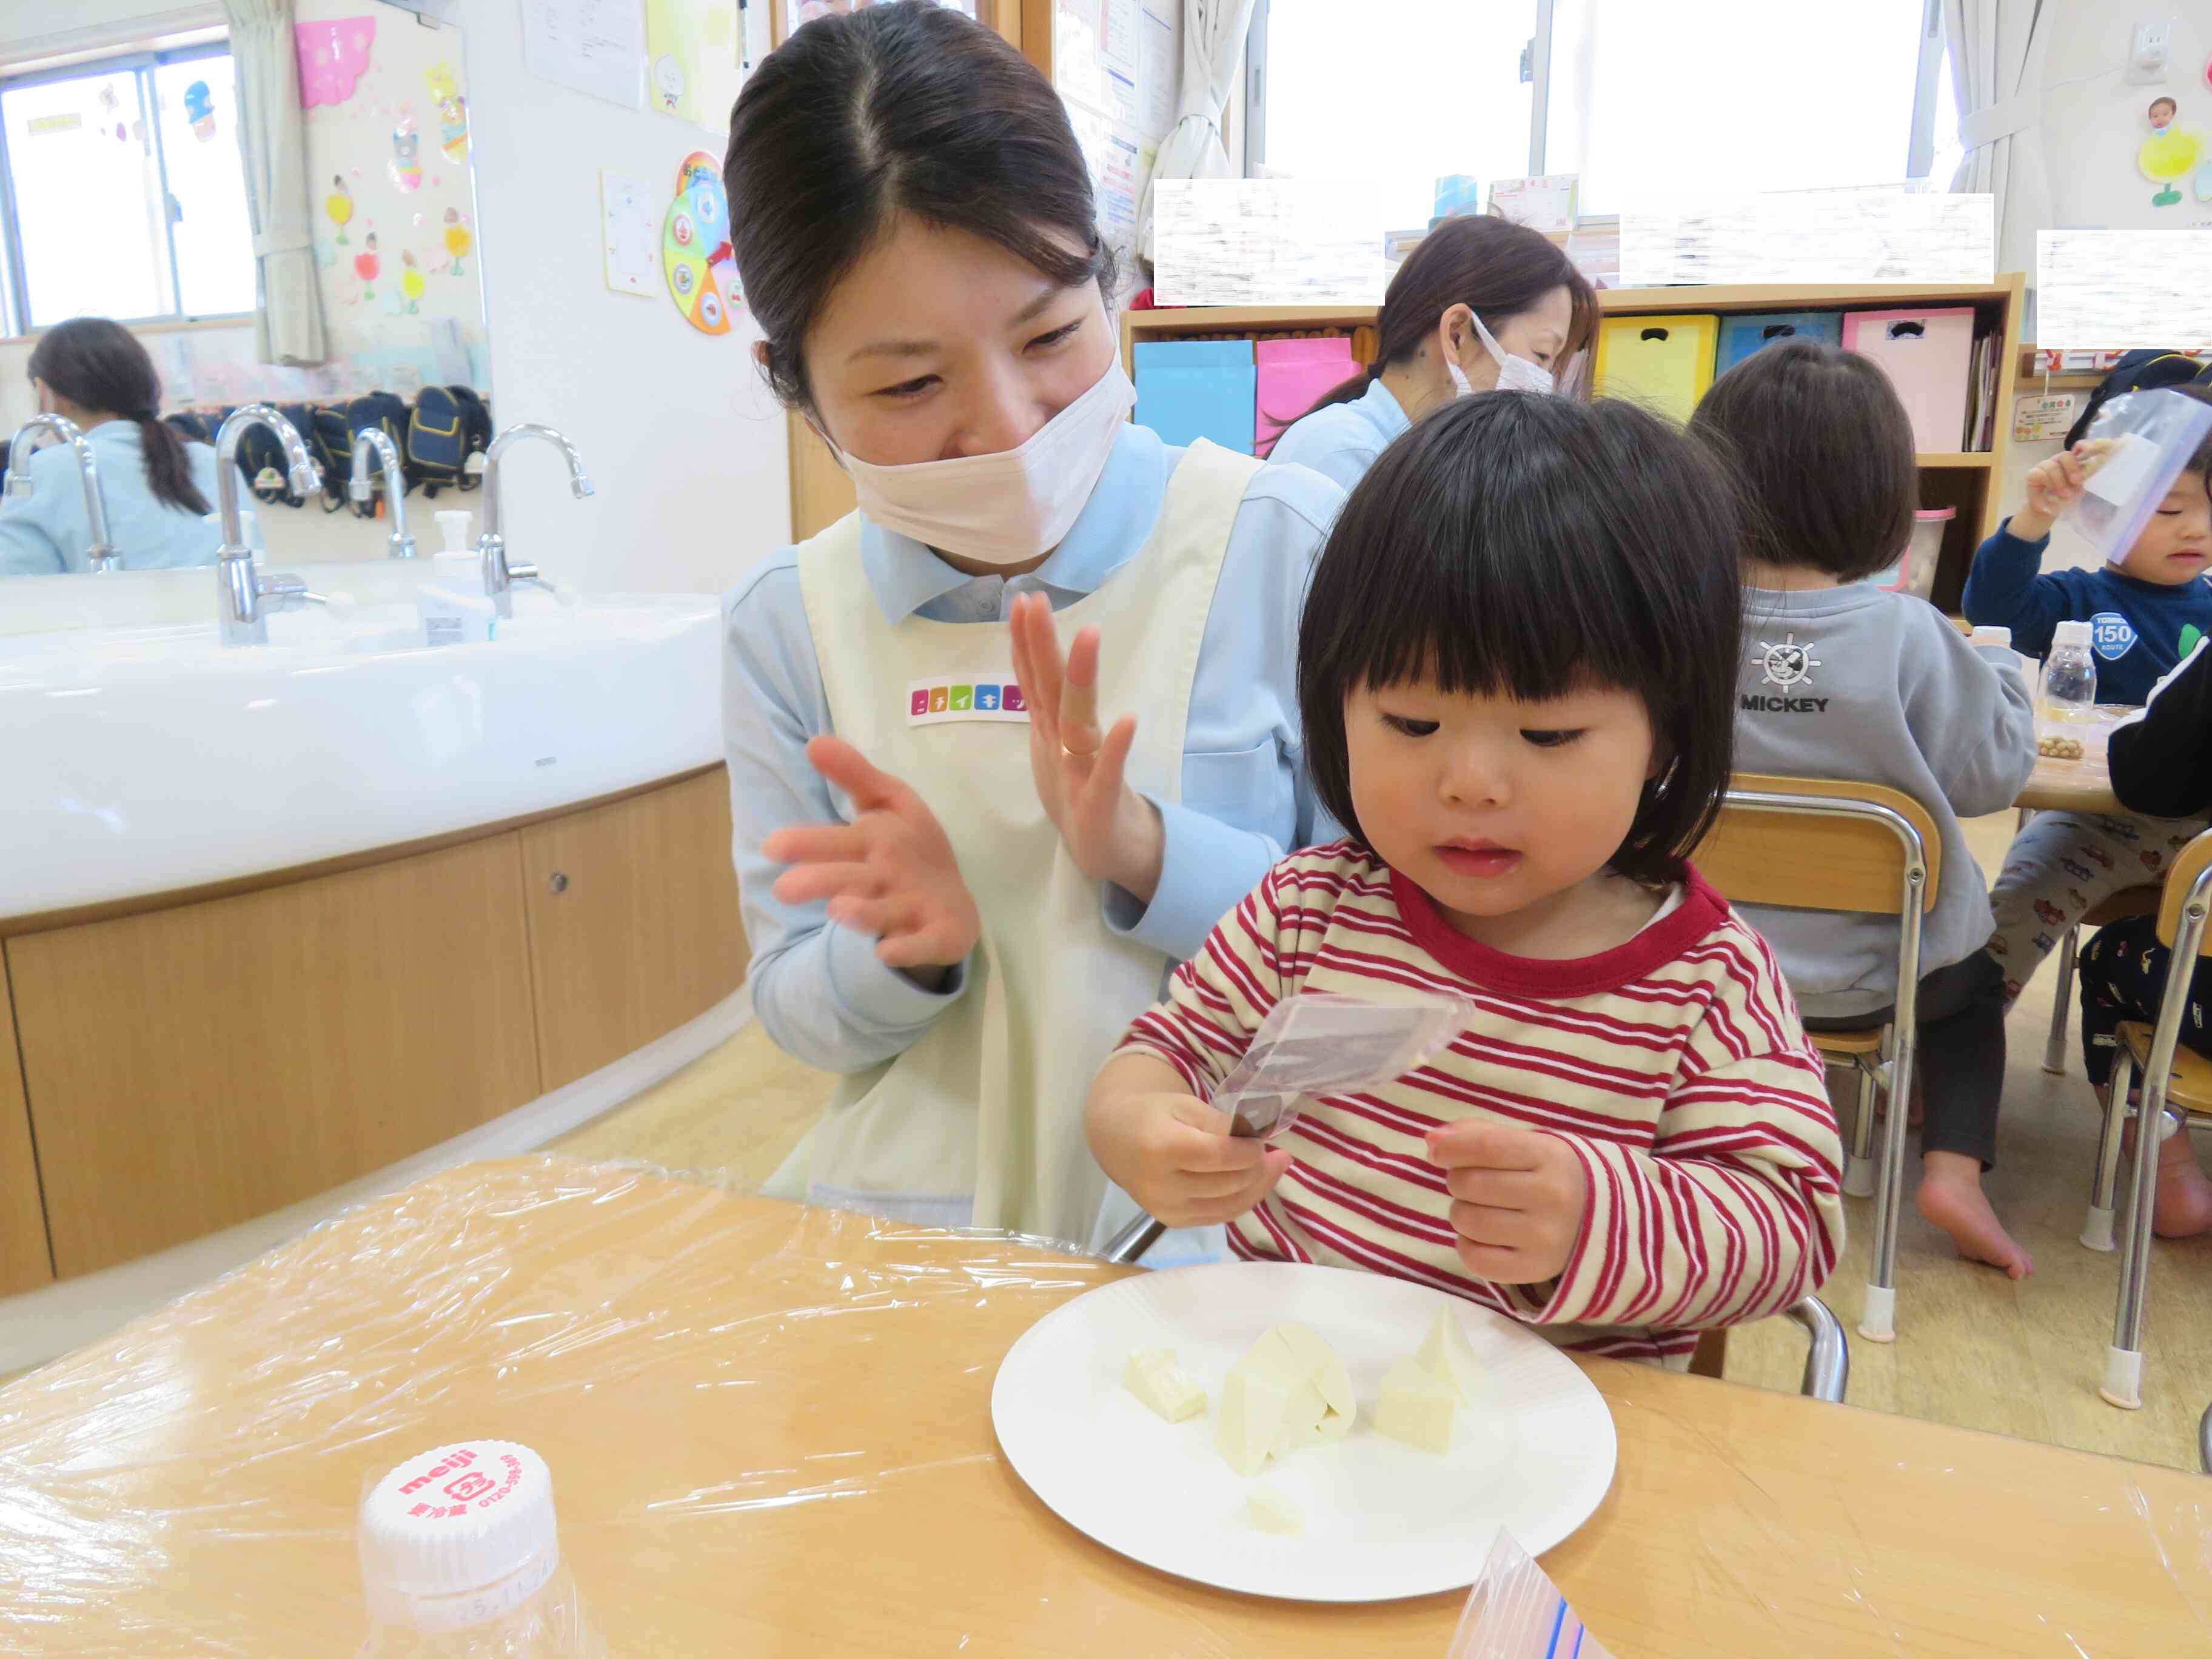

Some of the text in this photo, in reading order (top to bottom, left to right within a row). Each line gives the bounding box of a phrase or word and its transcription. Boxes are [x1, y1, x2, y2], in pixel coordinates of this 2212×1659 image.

[2095, 625, 2132, 643] 150
[1741, 694, 1829, 712] MICKEY
[398, 1449, 478, 1495] meiji
